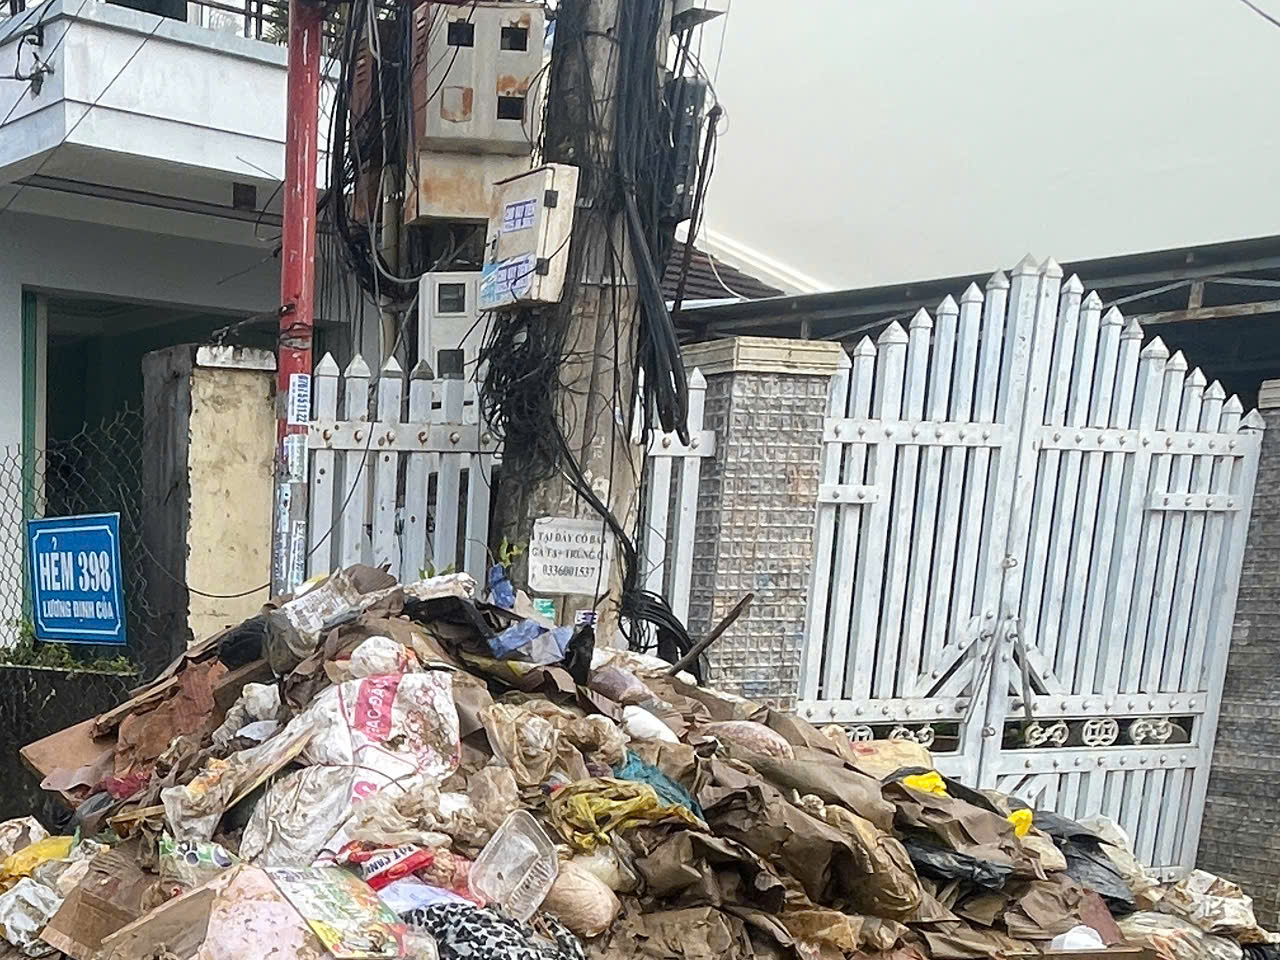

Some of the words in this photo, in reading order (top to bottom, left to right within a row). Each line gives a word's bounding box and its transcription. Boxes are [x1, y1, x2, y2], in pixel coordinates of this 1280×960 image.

[39, 536, 74, 592] HẺM
[78, 551, 111, 592] 398
[96, 595, 114, 619] CỦA
